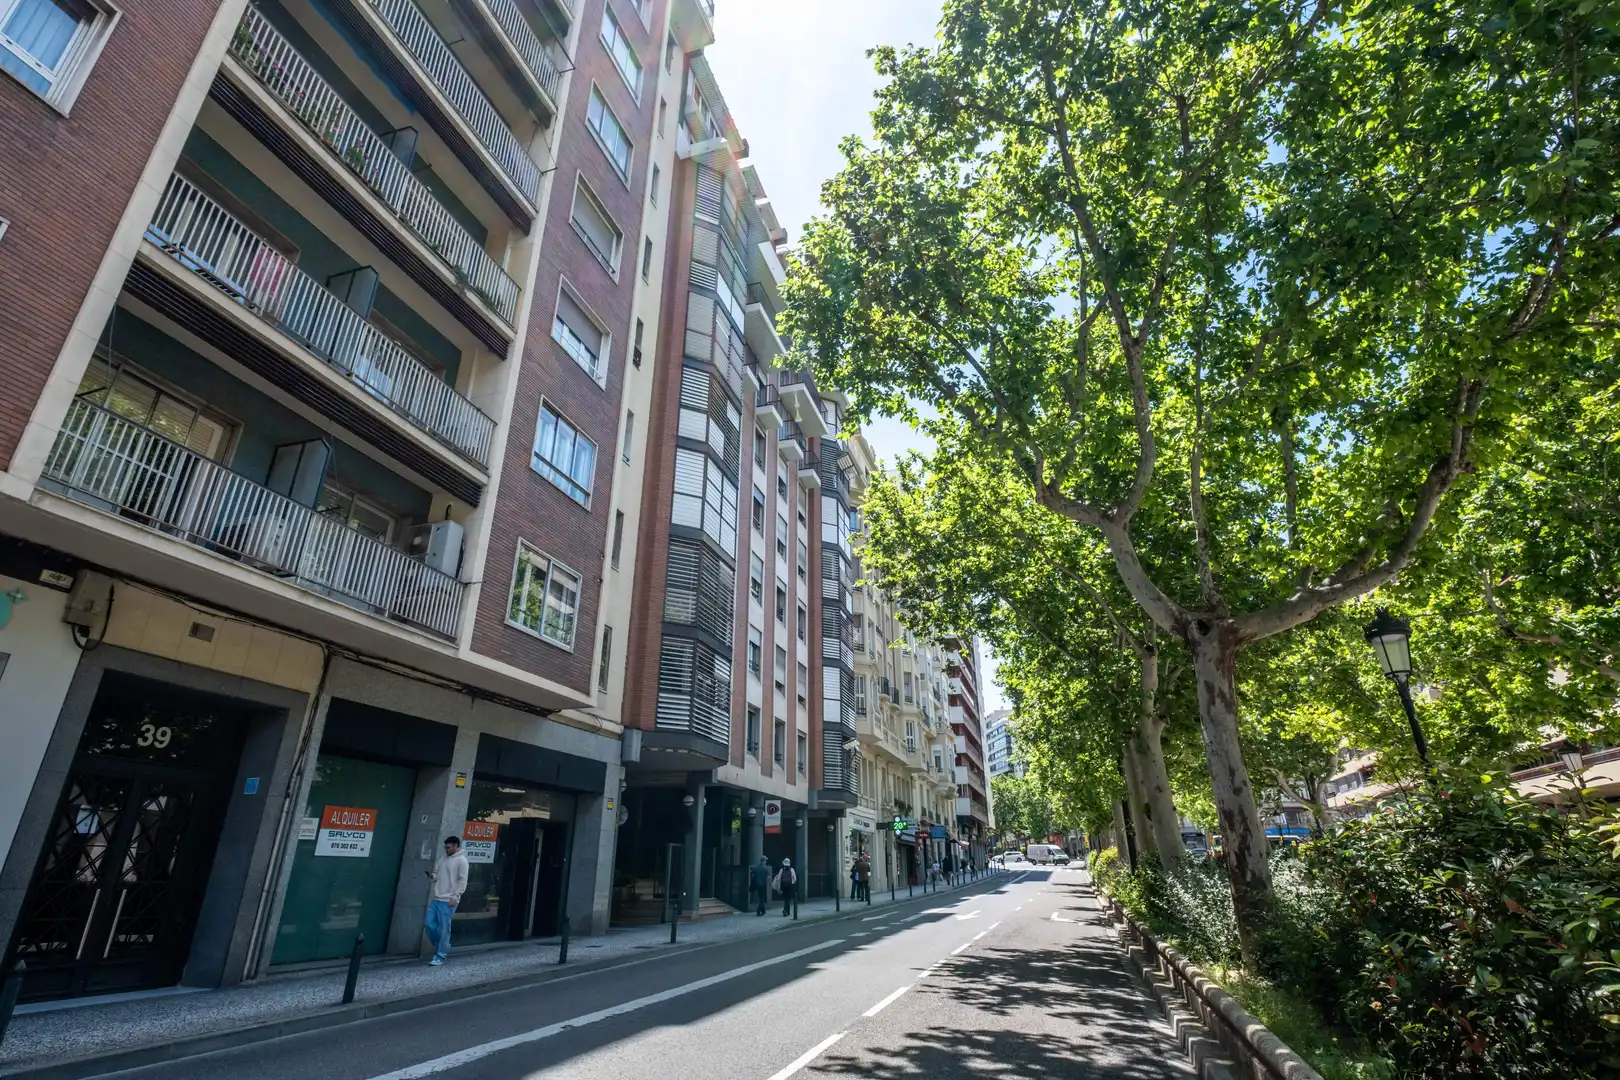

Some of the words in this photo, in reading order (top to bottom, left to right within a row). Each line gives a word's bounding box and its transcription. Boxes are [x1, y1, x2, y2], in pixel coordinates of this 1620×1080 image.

[137, 724, 172, 749] 39
[330, 811, 371, 826] ALQUILER
[327, 830, 366, 839] SALYCO
